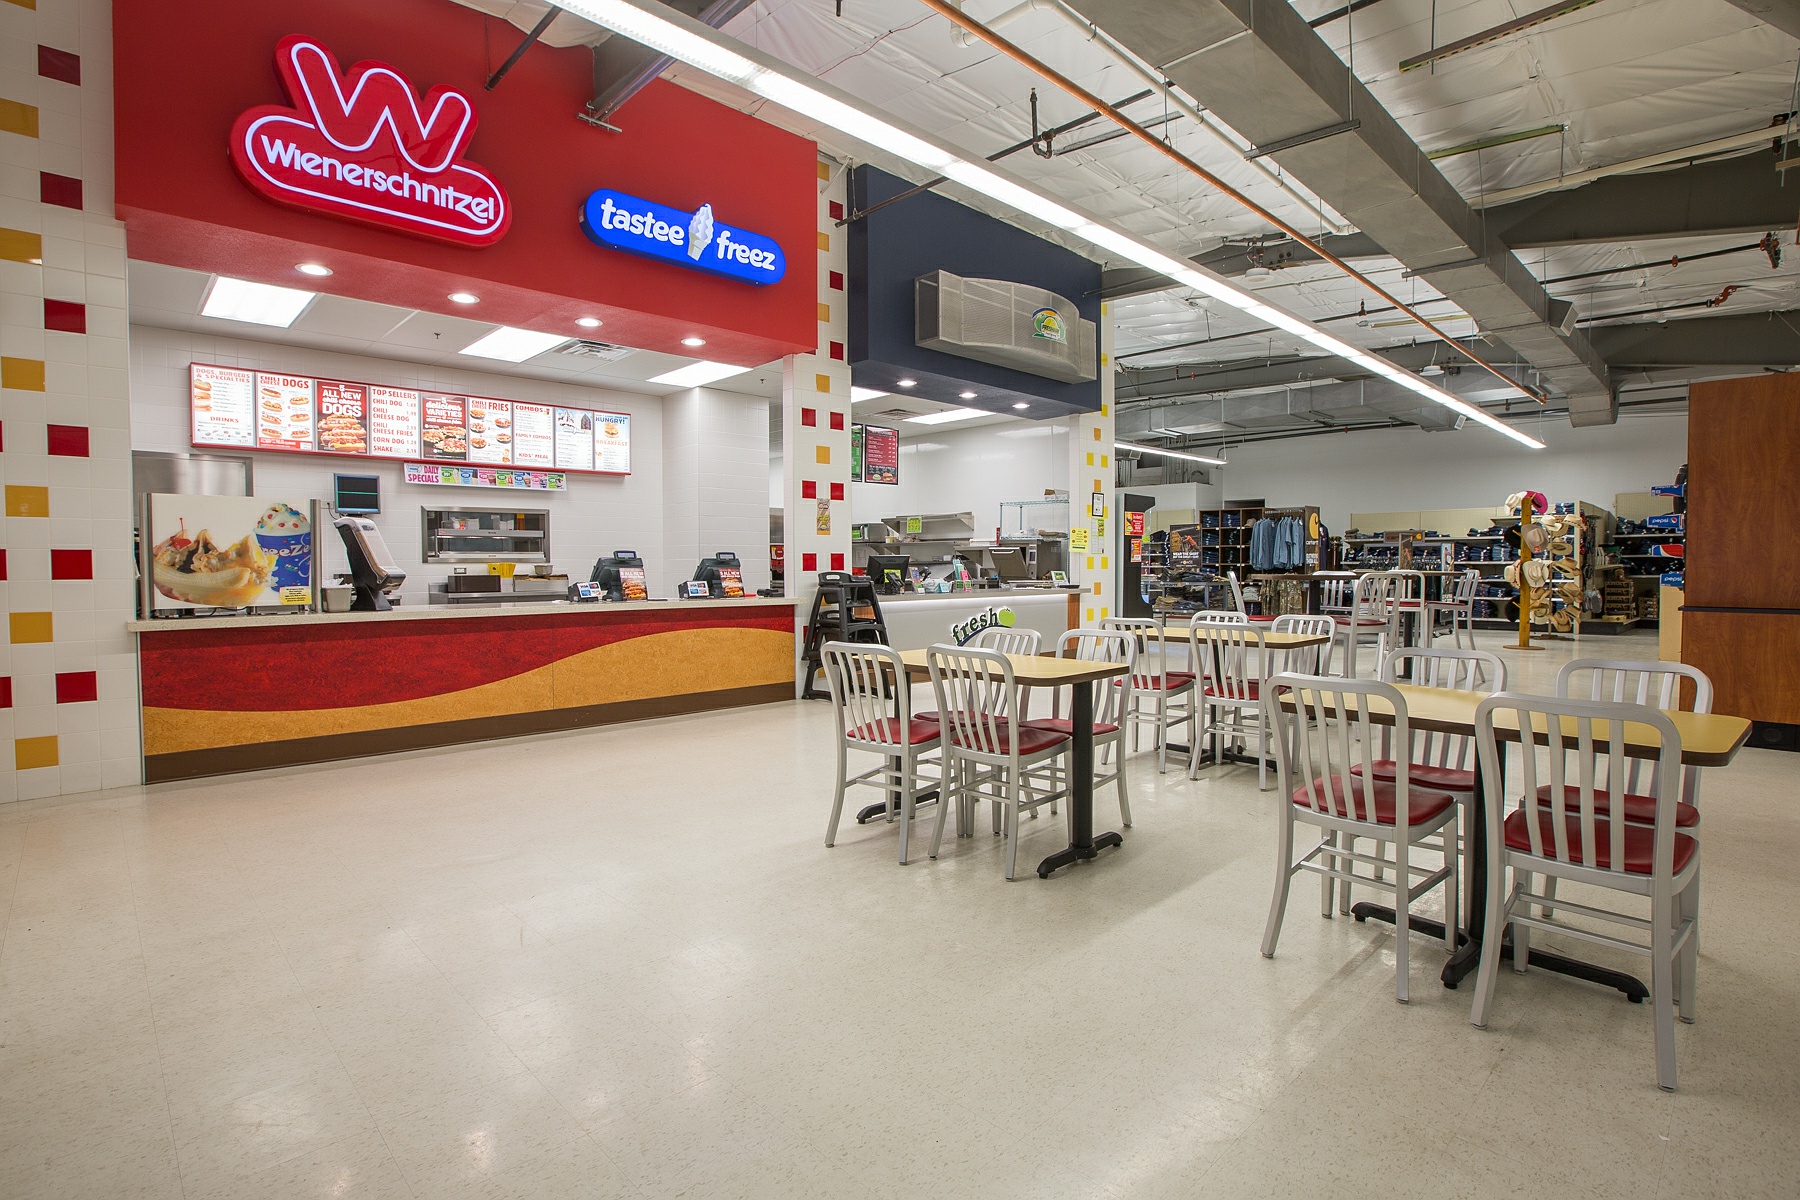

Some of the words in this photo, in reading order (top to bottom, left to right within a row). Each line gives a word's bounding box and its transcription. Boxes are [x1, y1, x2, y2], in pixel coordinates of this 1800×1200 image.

[261, 134, 494, 224] Wienerschnitzel
[600, 198, 685, 246] tastee
[716, 230, 776, 270] freez
[205, 374, 250, 383] SPECIALTIES
[283, 378, 309, 388] DOGS
[322, 389, 339, 398] ALL
[341, 391, 361, 400] NEW
[388, 391, 417, 399] SELLERS
[322, 403, 362, 417] DOGS
[488, 402, 509, 412] FRIES
[426, 408, 462, 417] VARIETIES
[424, 466, 439, 474] DAILY
[408, 474, 439, 483] SPECIALS
[952, 608, 998, 646] fresh
